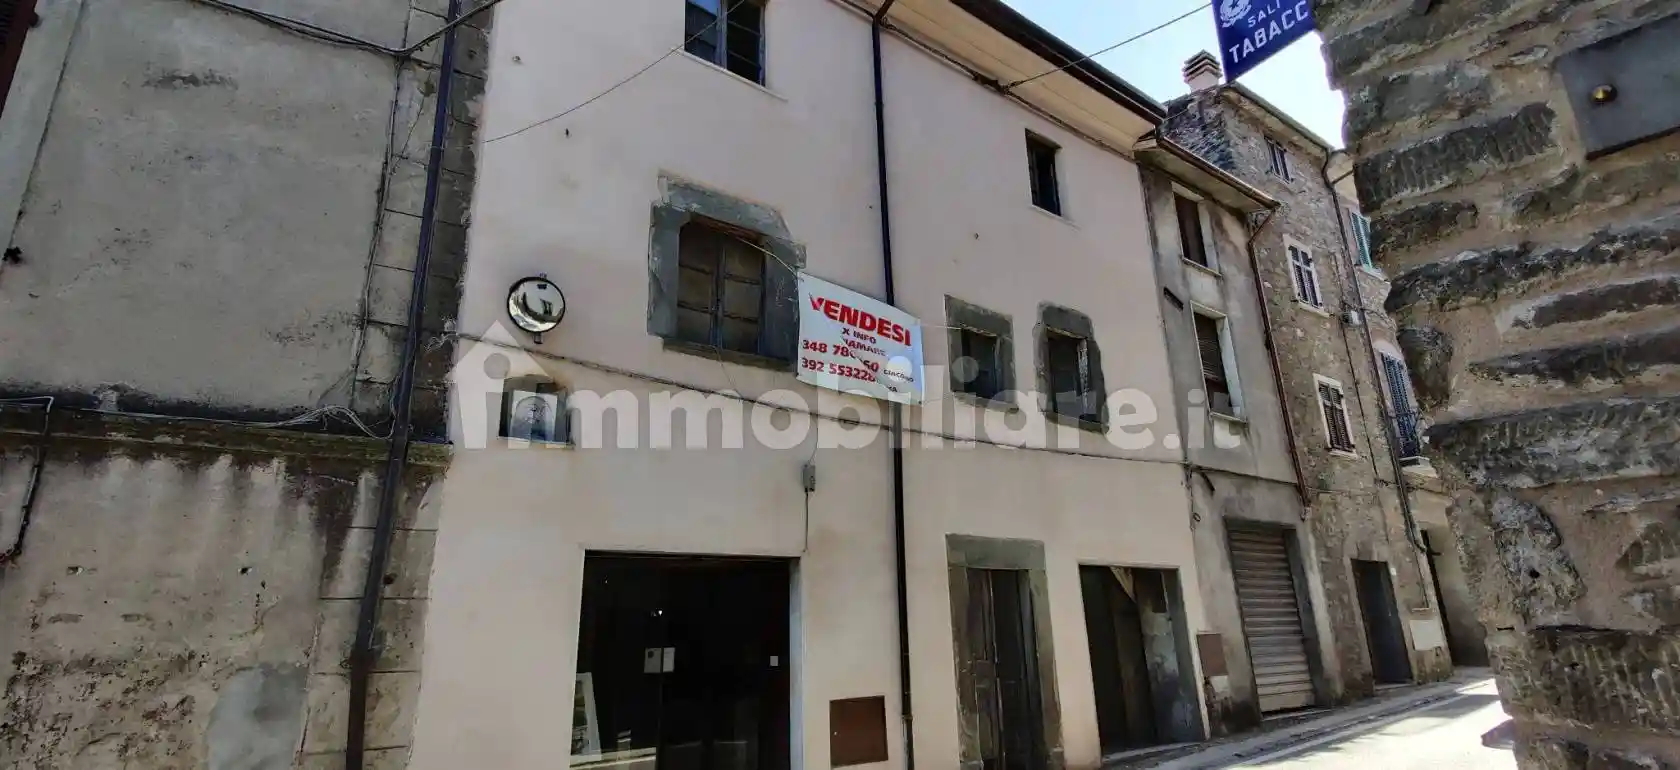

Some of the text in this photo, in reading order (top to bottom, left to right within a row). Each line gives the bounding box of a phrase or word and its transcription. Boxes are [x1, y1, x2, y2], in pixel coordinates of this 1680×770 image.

[1229, 0, 1309, 63] TABACC
[808, 292, 912, 347] VENDESI
[841, 327, 877, 344] X INFO
[802, 339, 828, 354] 348
[801, 356, 825, 373] 392
